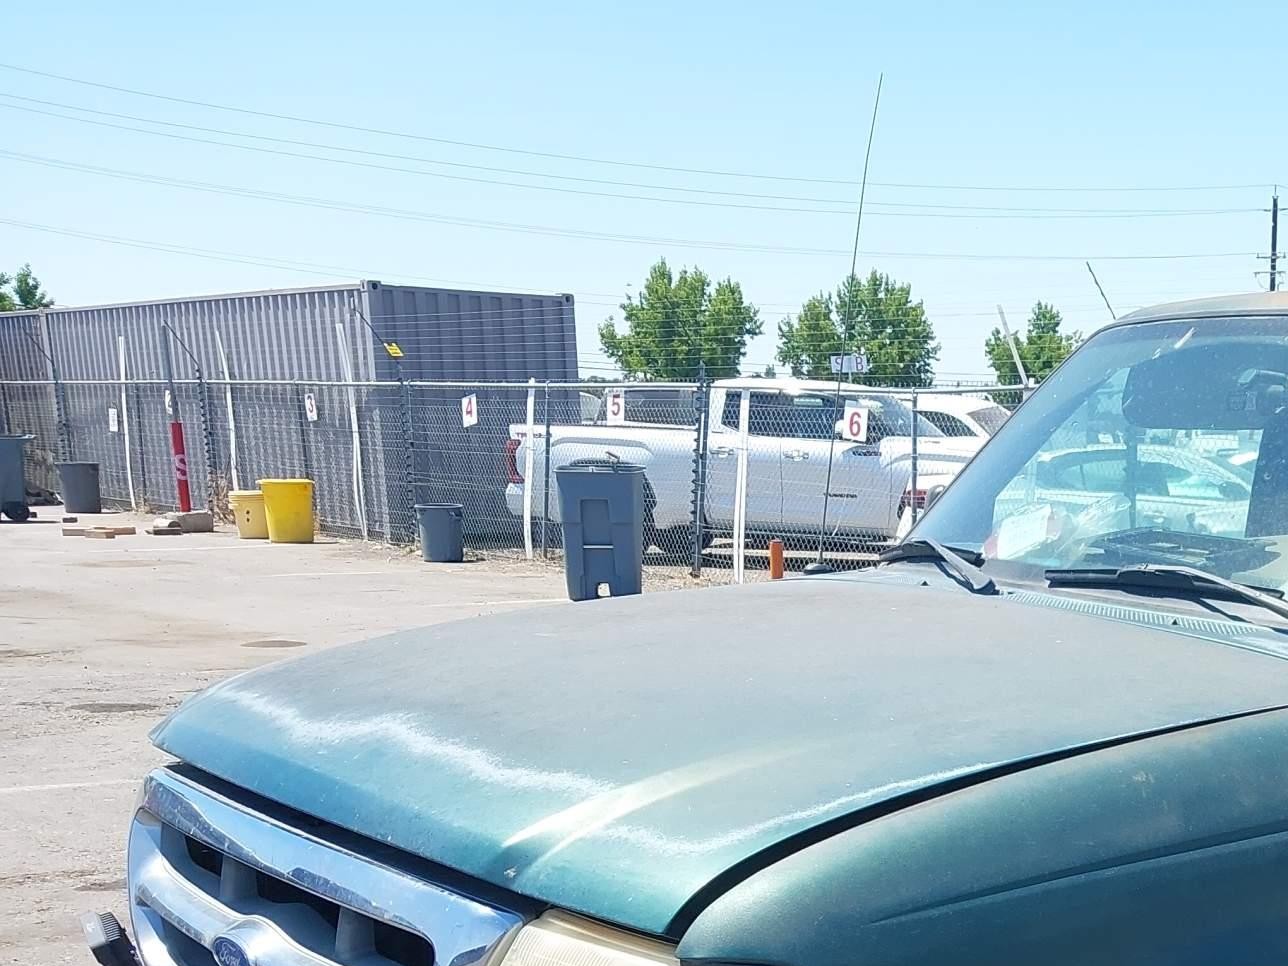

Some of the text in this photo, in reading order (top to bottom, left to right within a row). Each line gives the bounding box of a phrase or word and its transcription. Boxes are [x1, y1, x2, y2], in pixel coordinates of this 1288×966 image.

[307, 395, 315, 413] 3
[465, 398, 473, 418] 4
[611, 393, 621, 416] 5
[849, 411, 861, 437] 6
